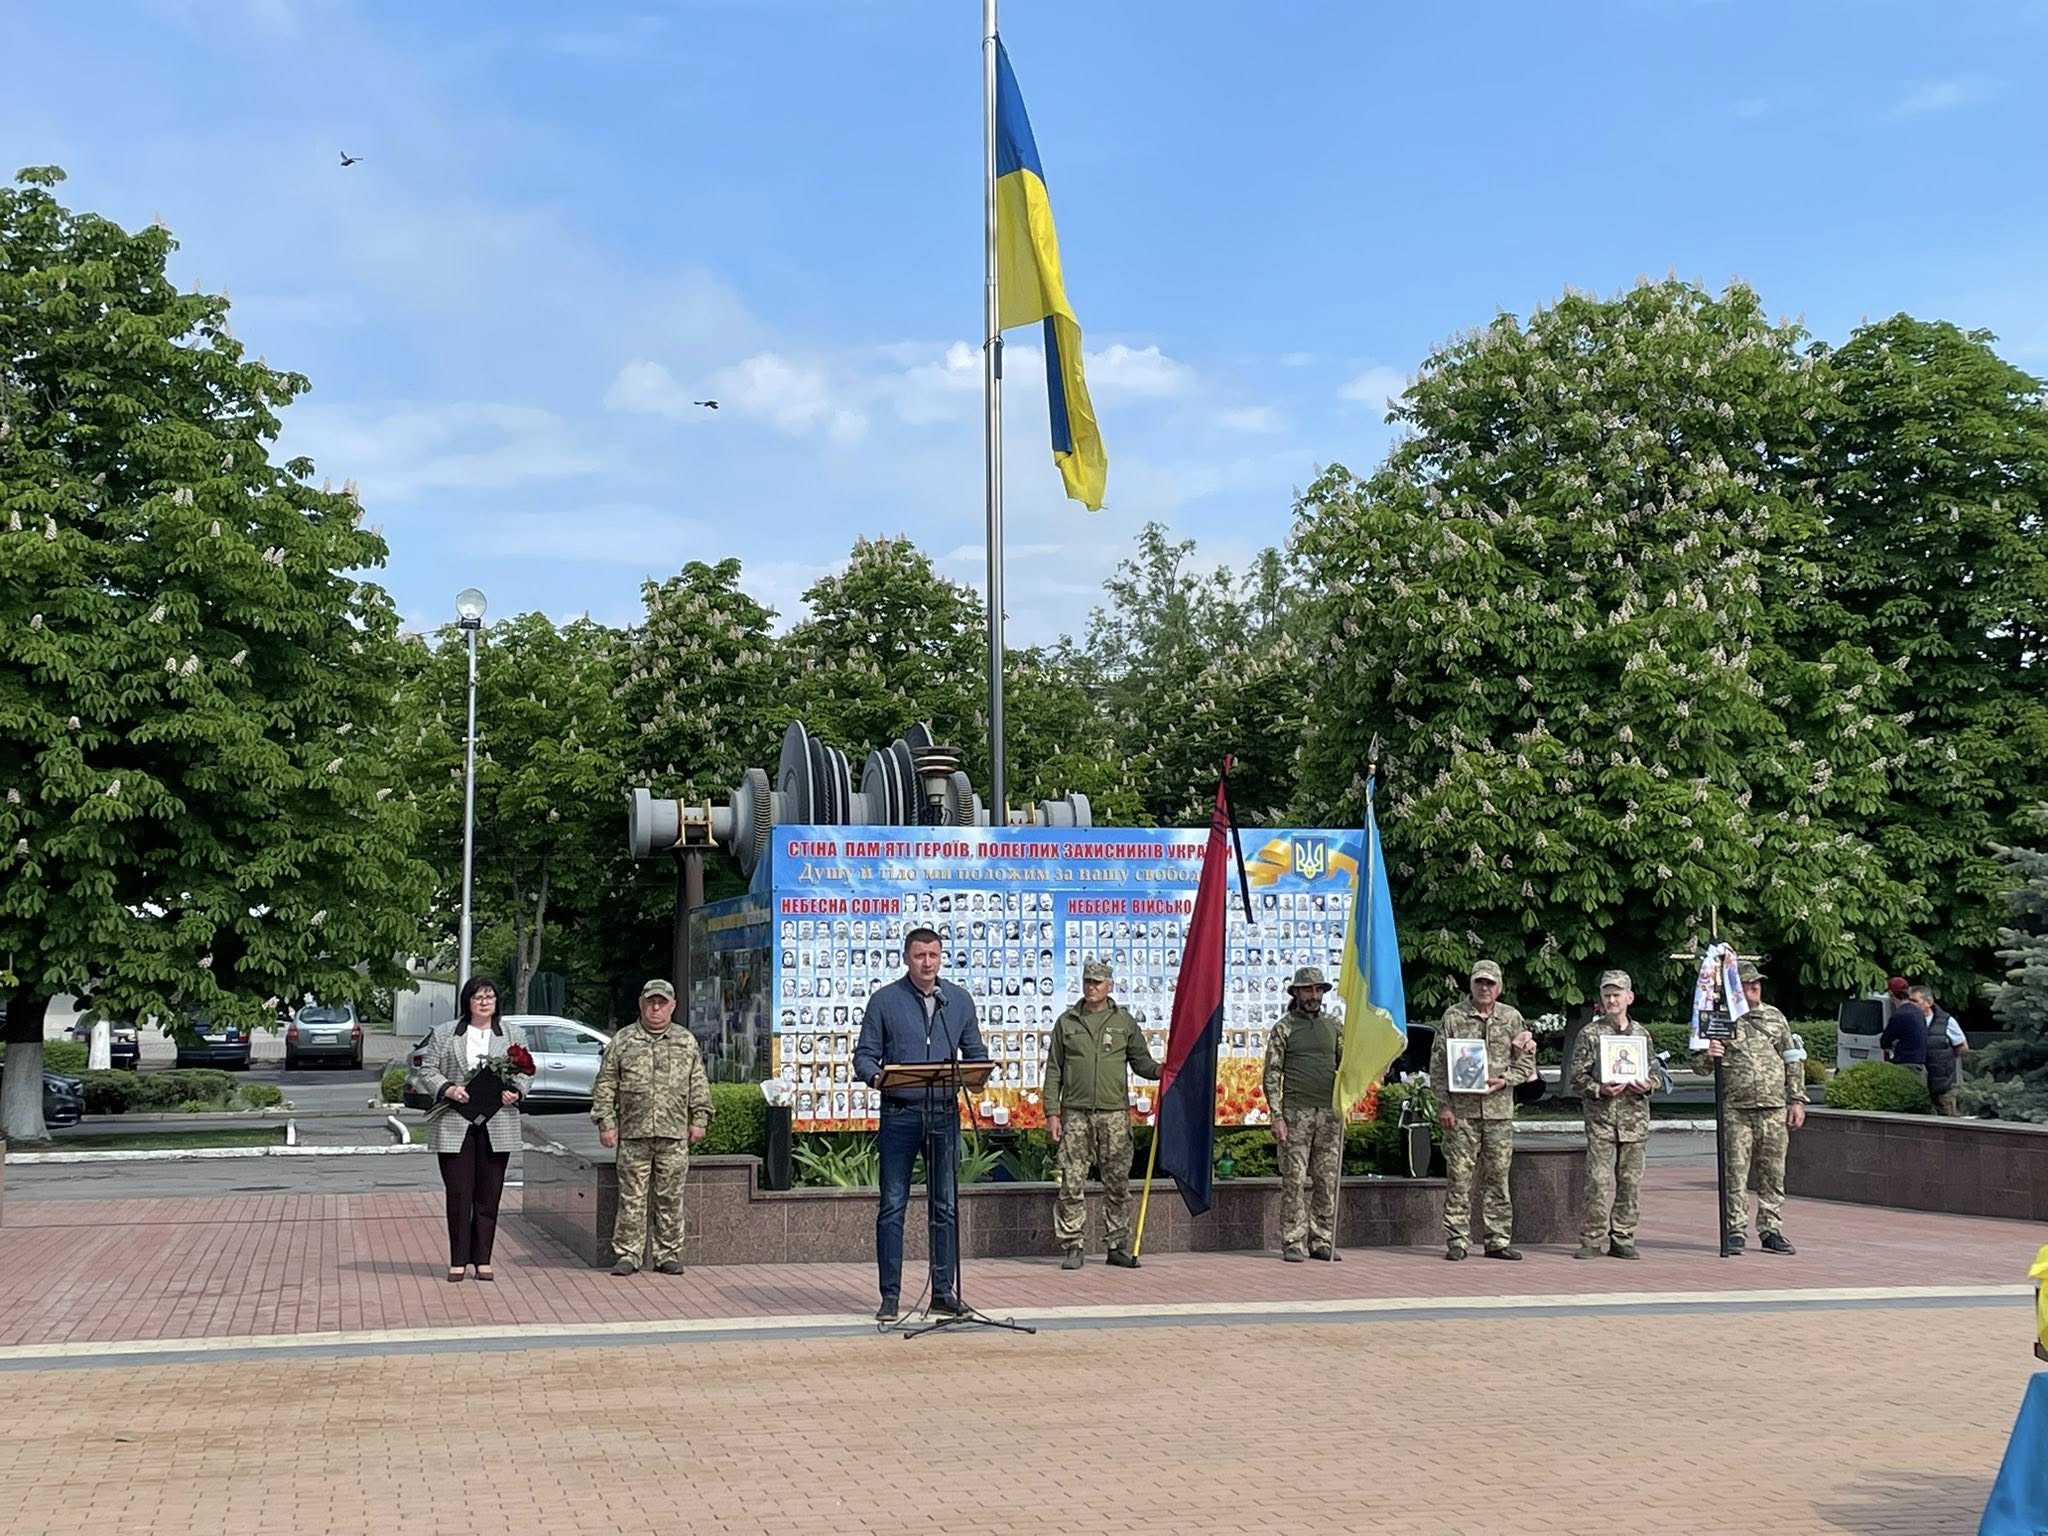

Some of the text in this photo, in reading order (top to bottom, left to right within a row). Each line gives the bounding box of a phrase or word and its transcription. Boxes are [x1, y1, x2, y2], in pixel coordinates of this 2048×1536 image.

[788, 841, 837, 858] СТІНА
[977, 842, 1060, 859] ПОЛЕГЛИХ
[1063, 842, 1163, 859] ЗАХИСНИКІВ
[798, 862, 853, 885] Душу
[956, 868, 1050, 882] положим
[1053, 868, 1074, 882] за
[1078, 868, 1128, 886] нашу
[1134, 865, 1201, 884] свобод
[781, 898, 847, 915] НЕБЕСНА
[851, 898, 900, 915] СОТНЯ
[1067, 899, 1127, 915] НЕБЕСНЕ
[1131, 896, 1192, 915] ВІЙСЬКО
